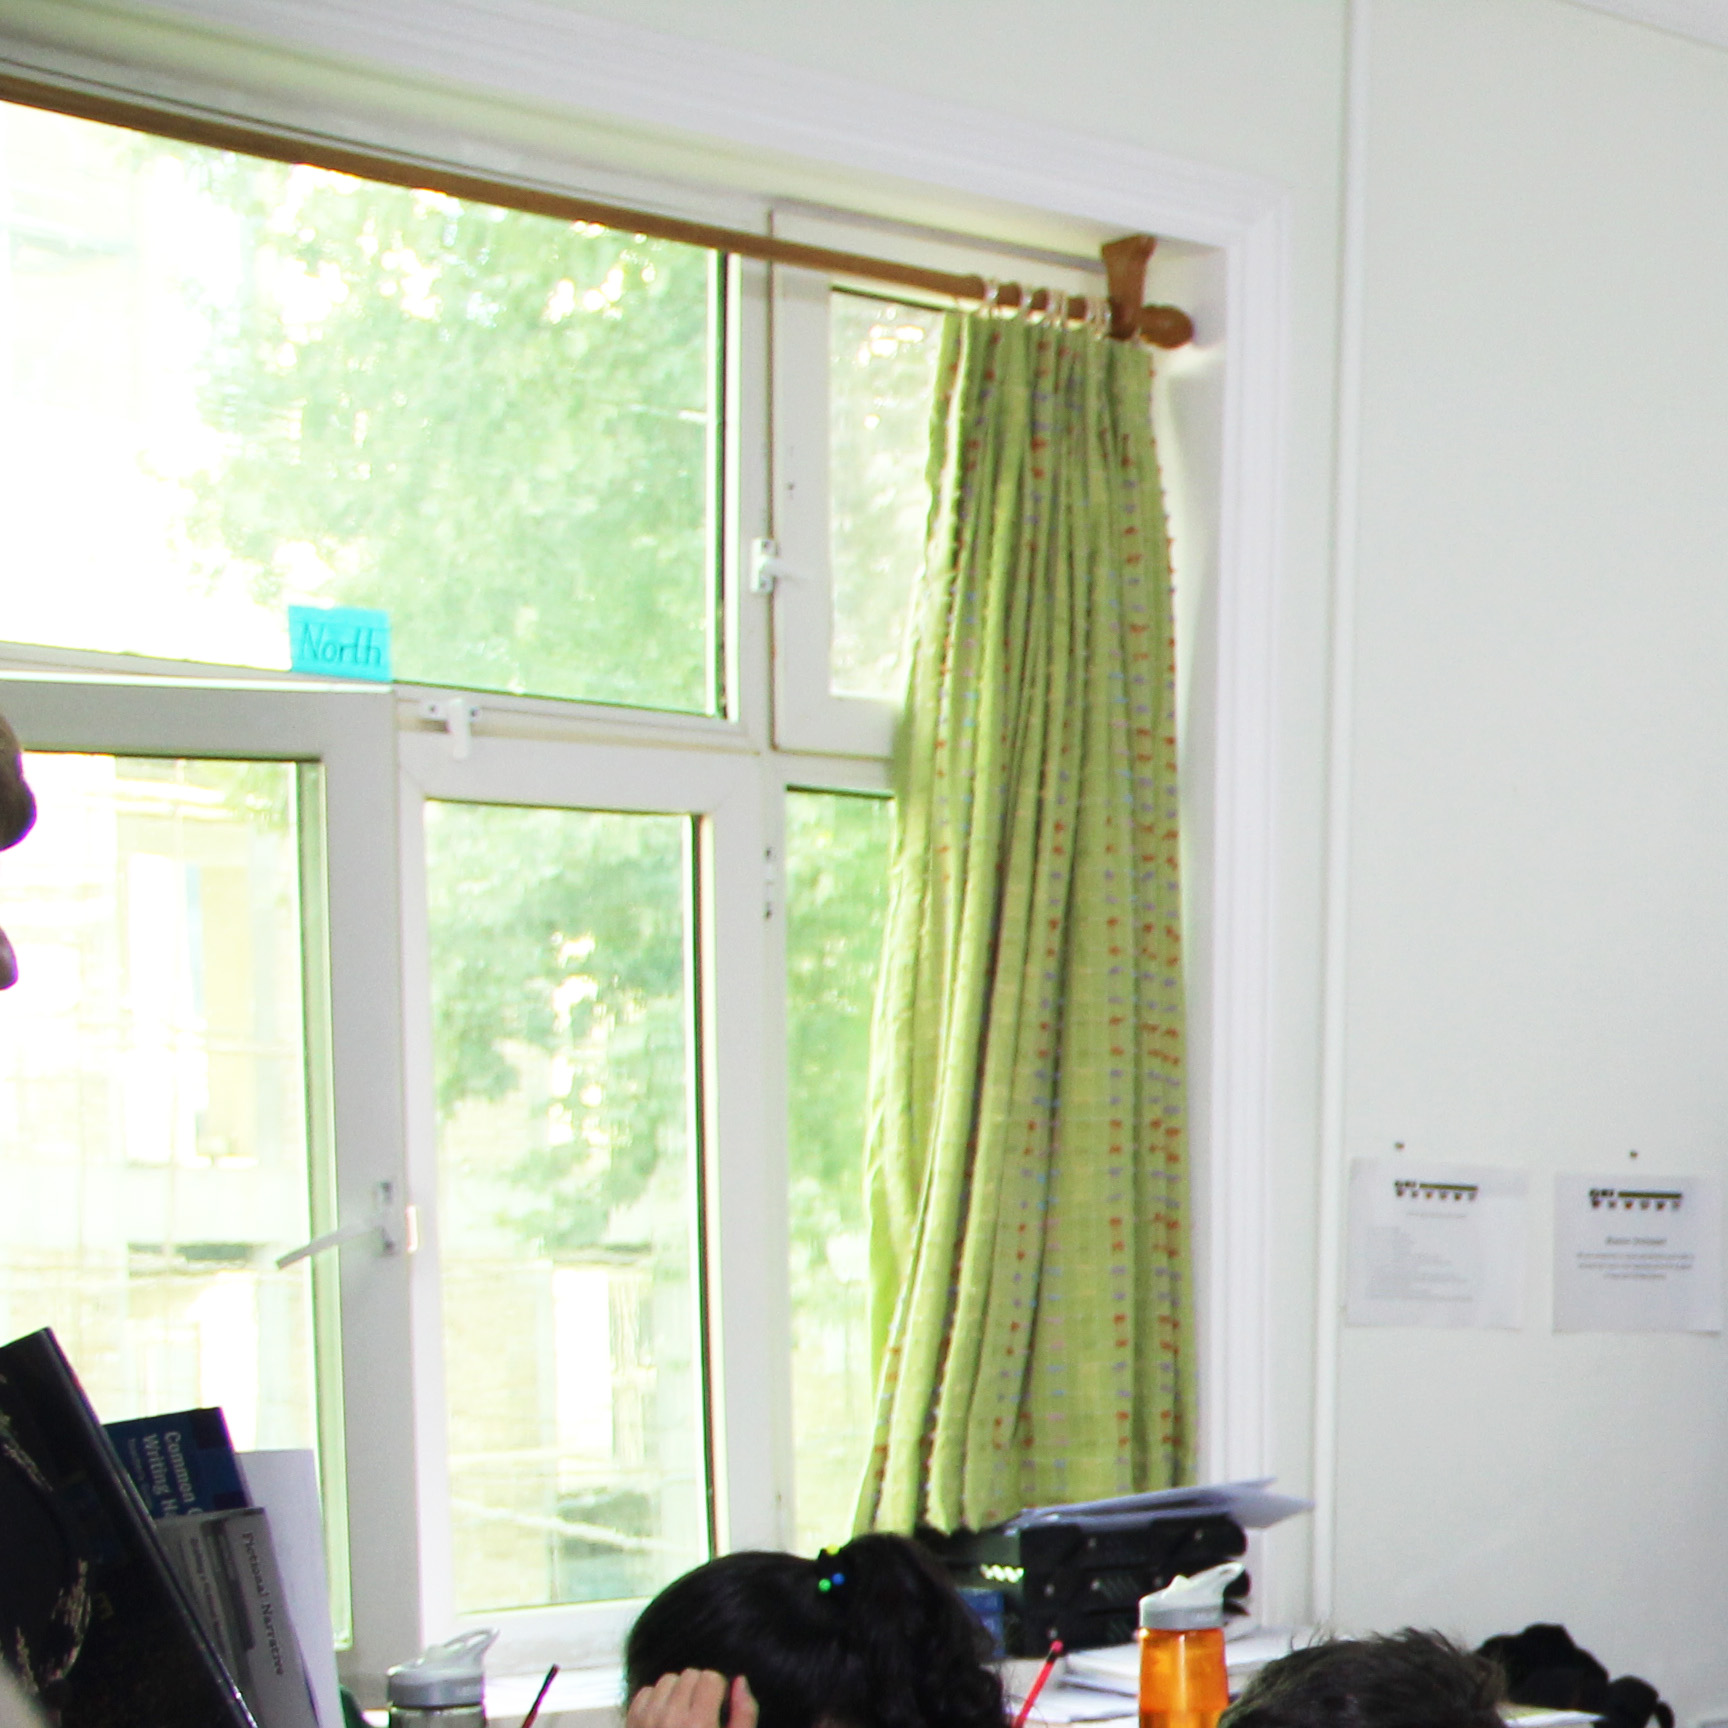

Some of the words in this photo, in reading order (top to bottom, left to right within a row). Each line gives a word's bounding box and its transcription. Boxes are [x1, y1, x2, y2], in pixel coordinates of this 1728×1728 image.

[301, 621, 382, 667] North
[142, 1433, 172, 1496] Writing
[163, 1429, 195, 1506] Common
[240, 1530, 271, 1600] Fictional
[259, 1603, 286, 1677] Narrative
